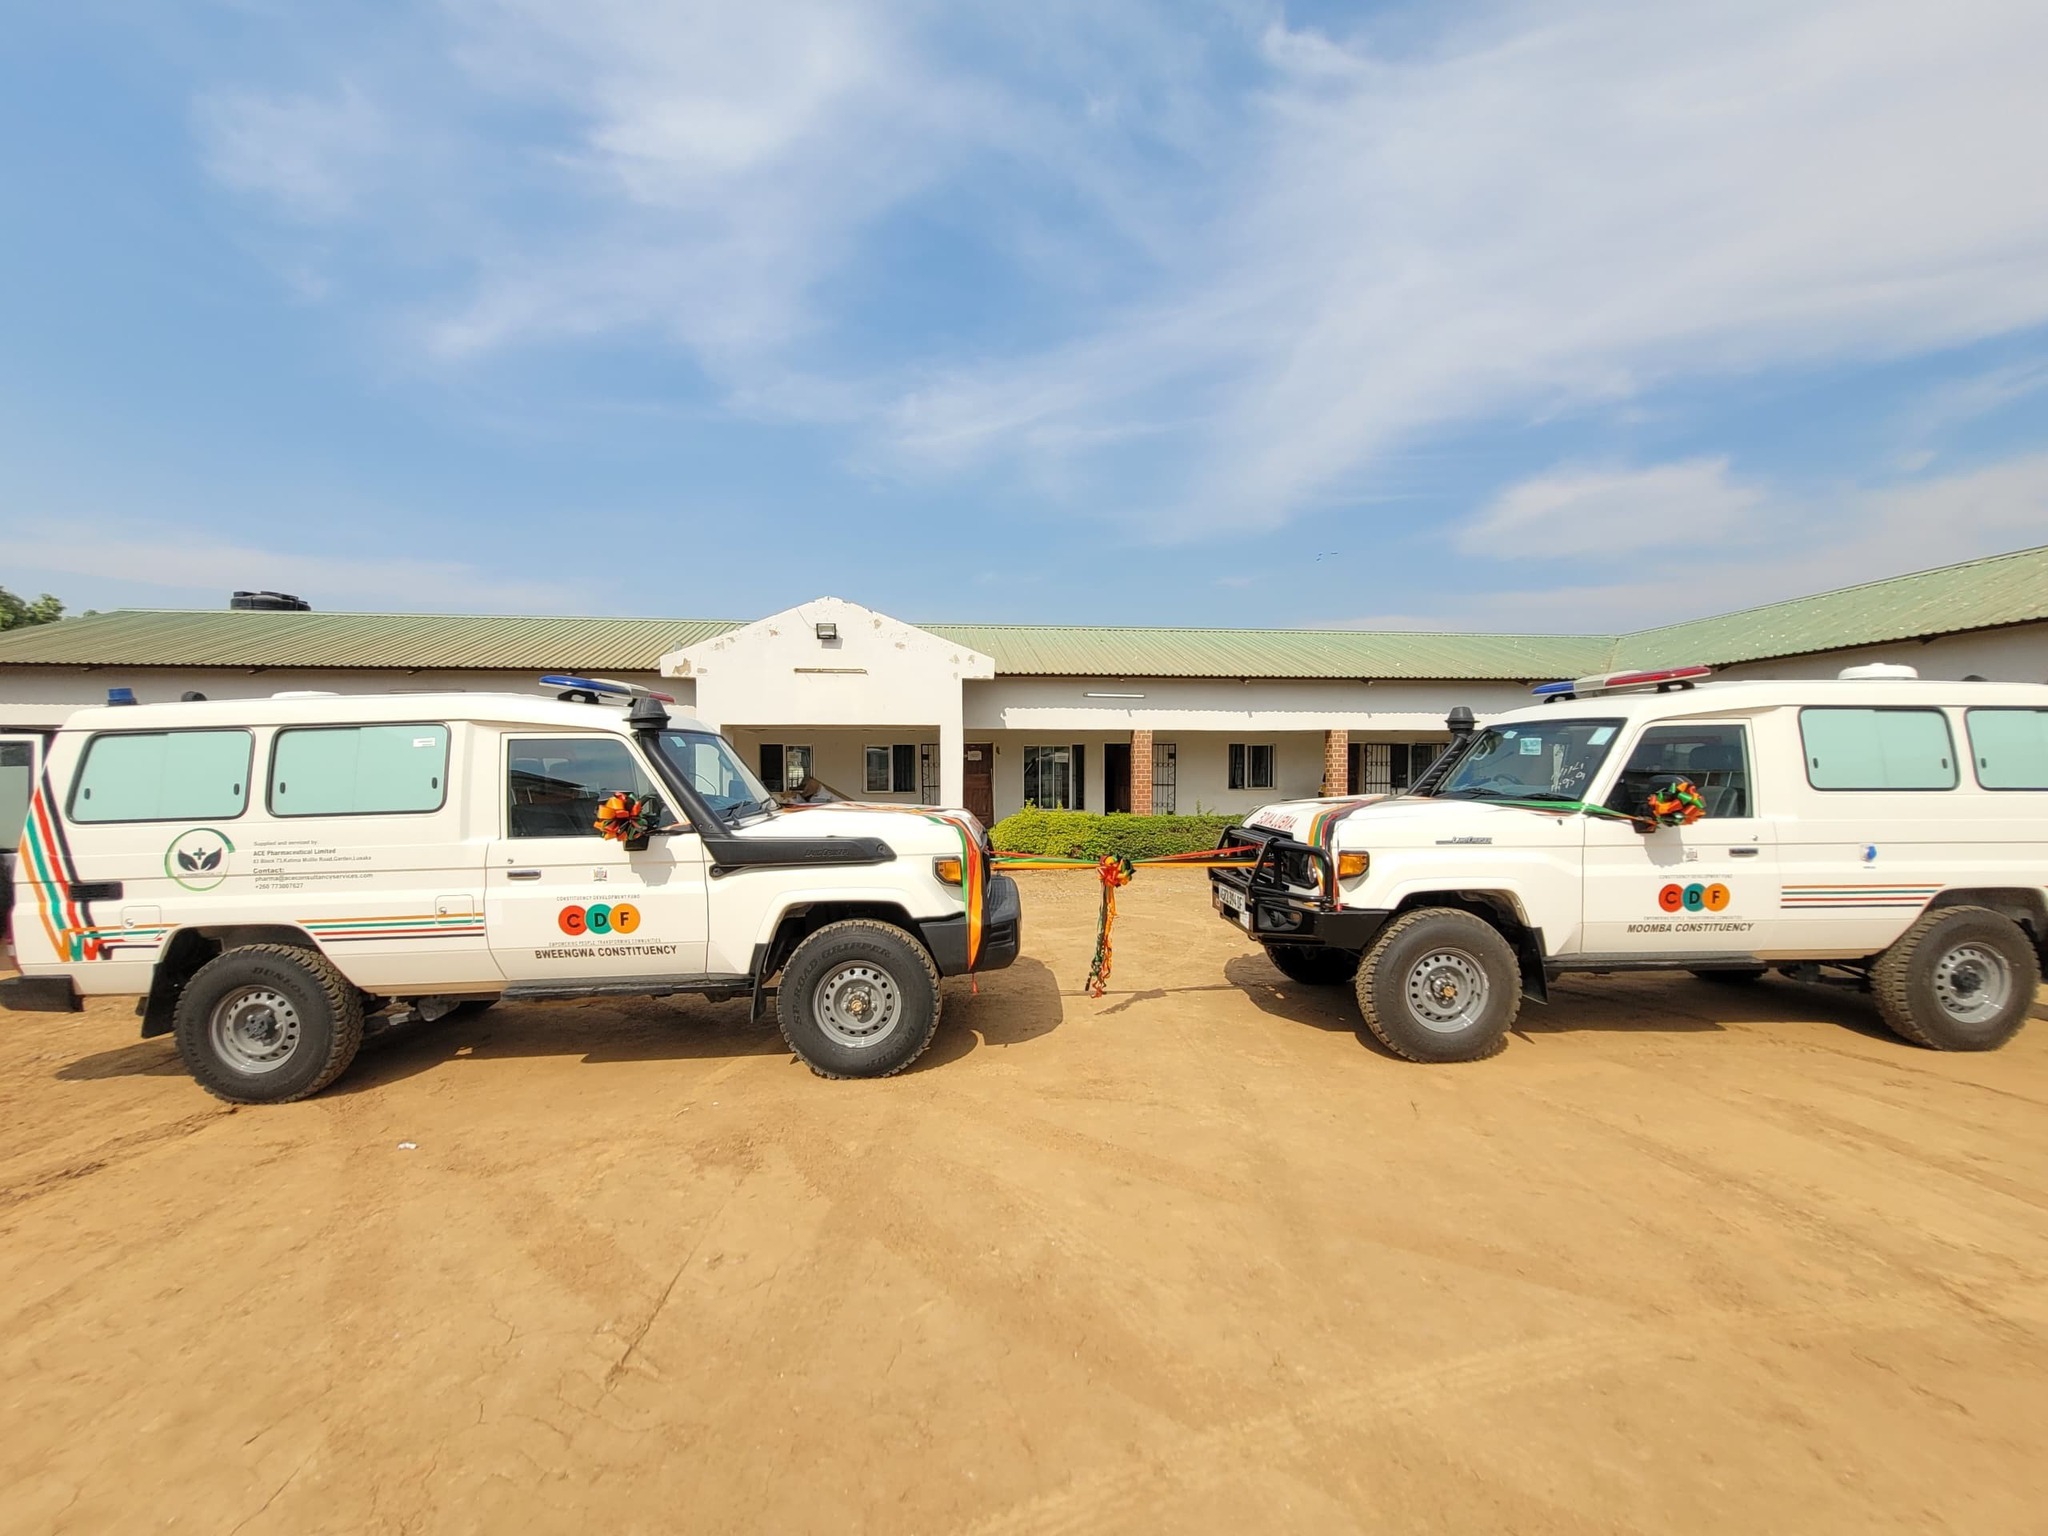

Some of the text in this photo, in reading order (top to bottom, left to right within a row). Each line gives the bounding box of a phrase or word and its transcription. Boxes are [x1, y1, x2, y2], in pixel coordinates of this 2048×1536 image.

[1665, 890, 1721, 905] CDF
[566, 912, 630, 928] CDF
[1627, 922, 1754, 933] MOOMBA CONSTITUENCY
[535, 945, 678, 960] BWEENGWA CONSTITUENCY
